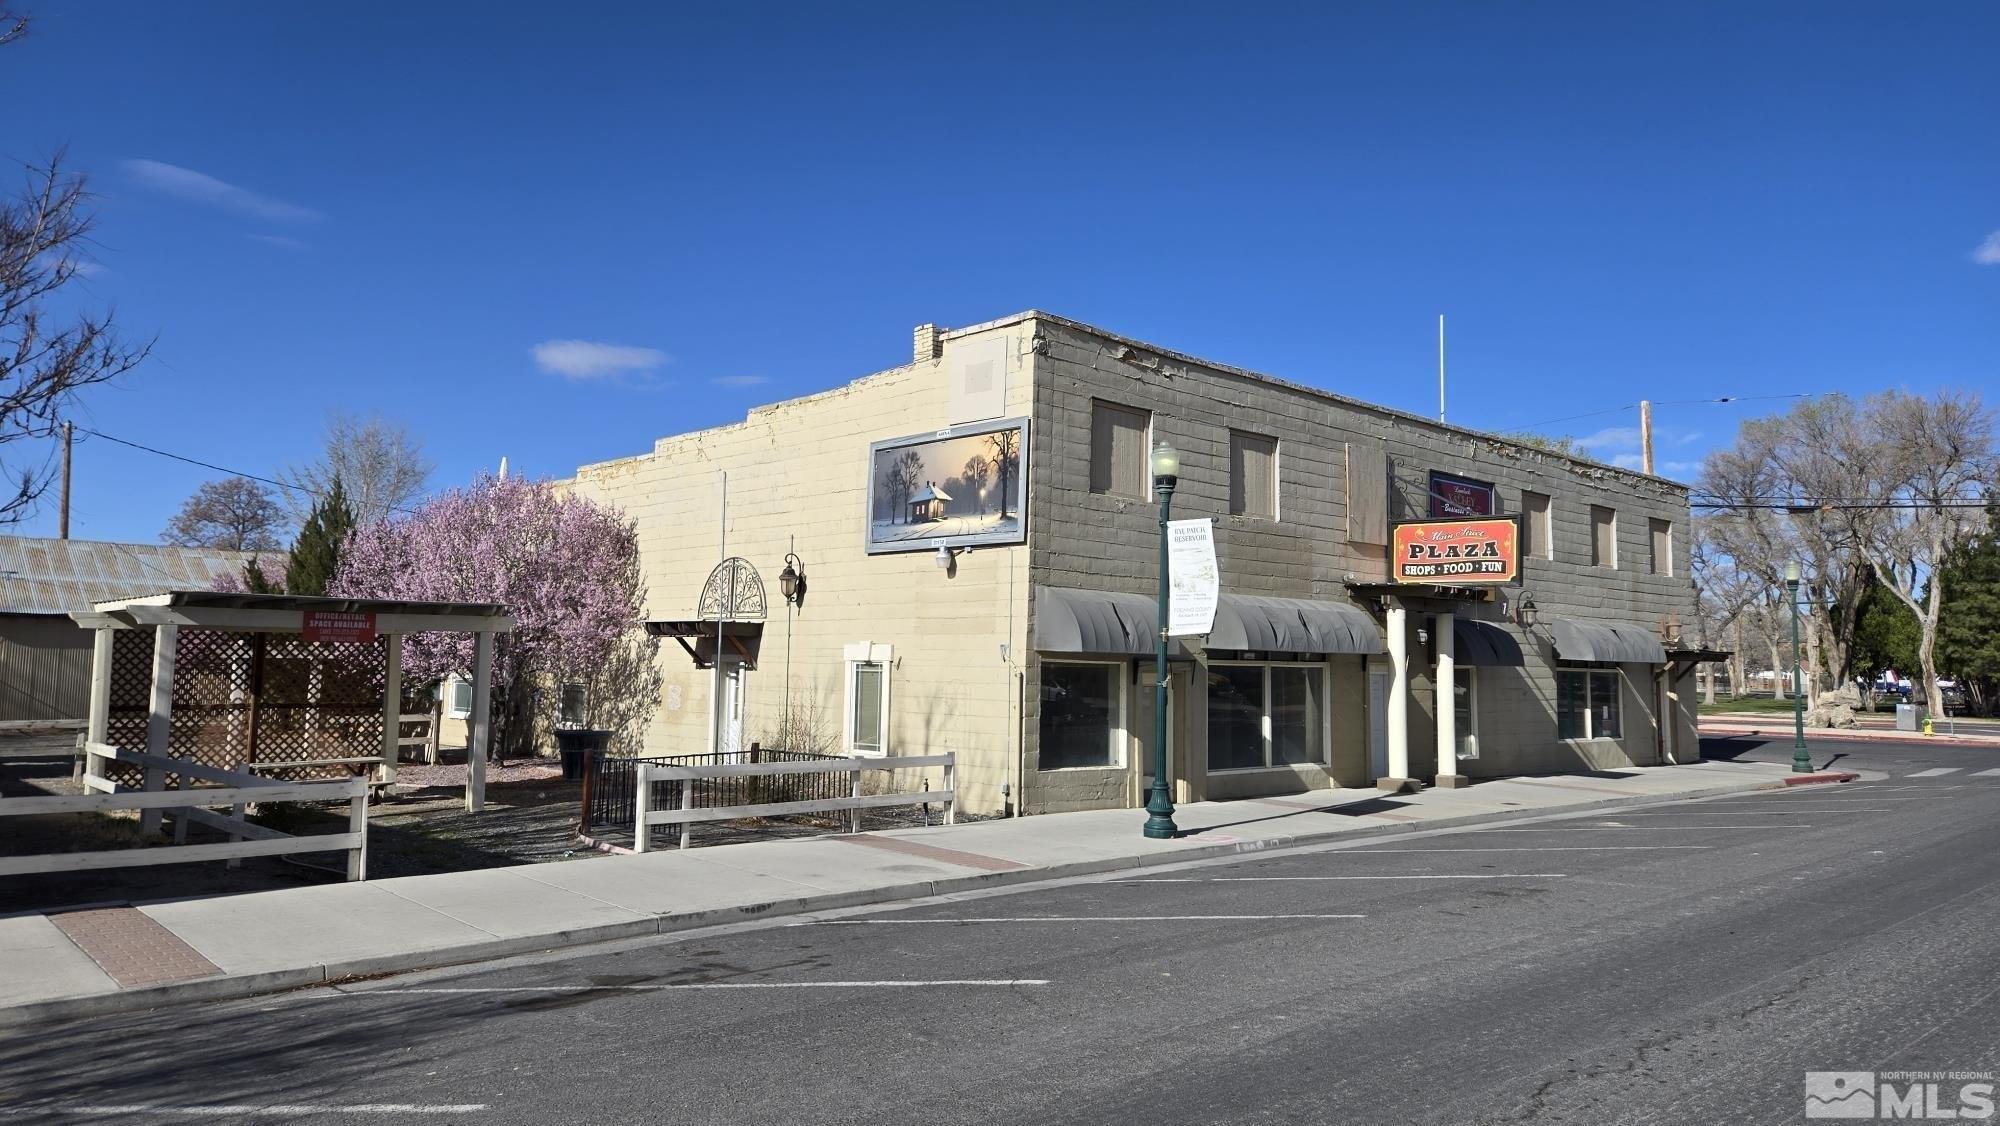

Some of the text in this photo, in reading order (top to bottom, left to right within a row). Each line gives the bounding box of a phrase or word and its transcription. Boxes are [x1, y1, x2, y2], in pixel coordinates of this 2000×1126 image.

[1431, 525, 1485, 541] Main Street
[1408, 540, 1500, 559] PLAZA
[1405, 561, 1503, 575] SHOPS FOOD FUN
[333, 620, 370, 629] AVAILABLE
